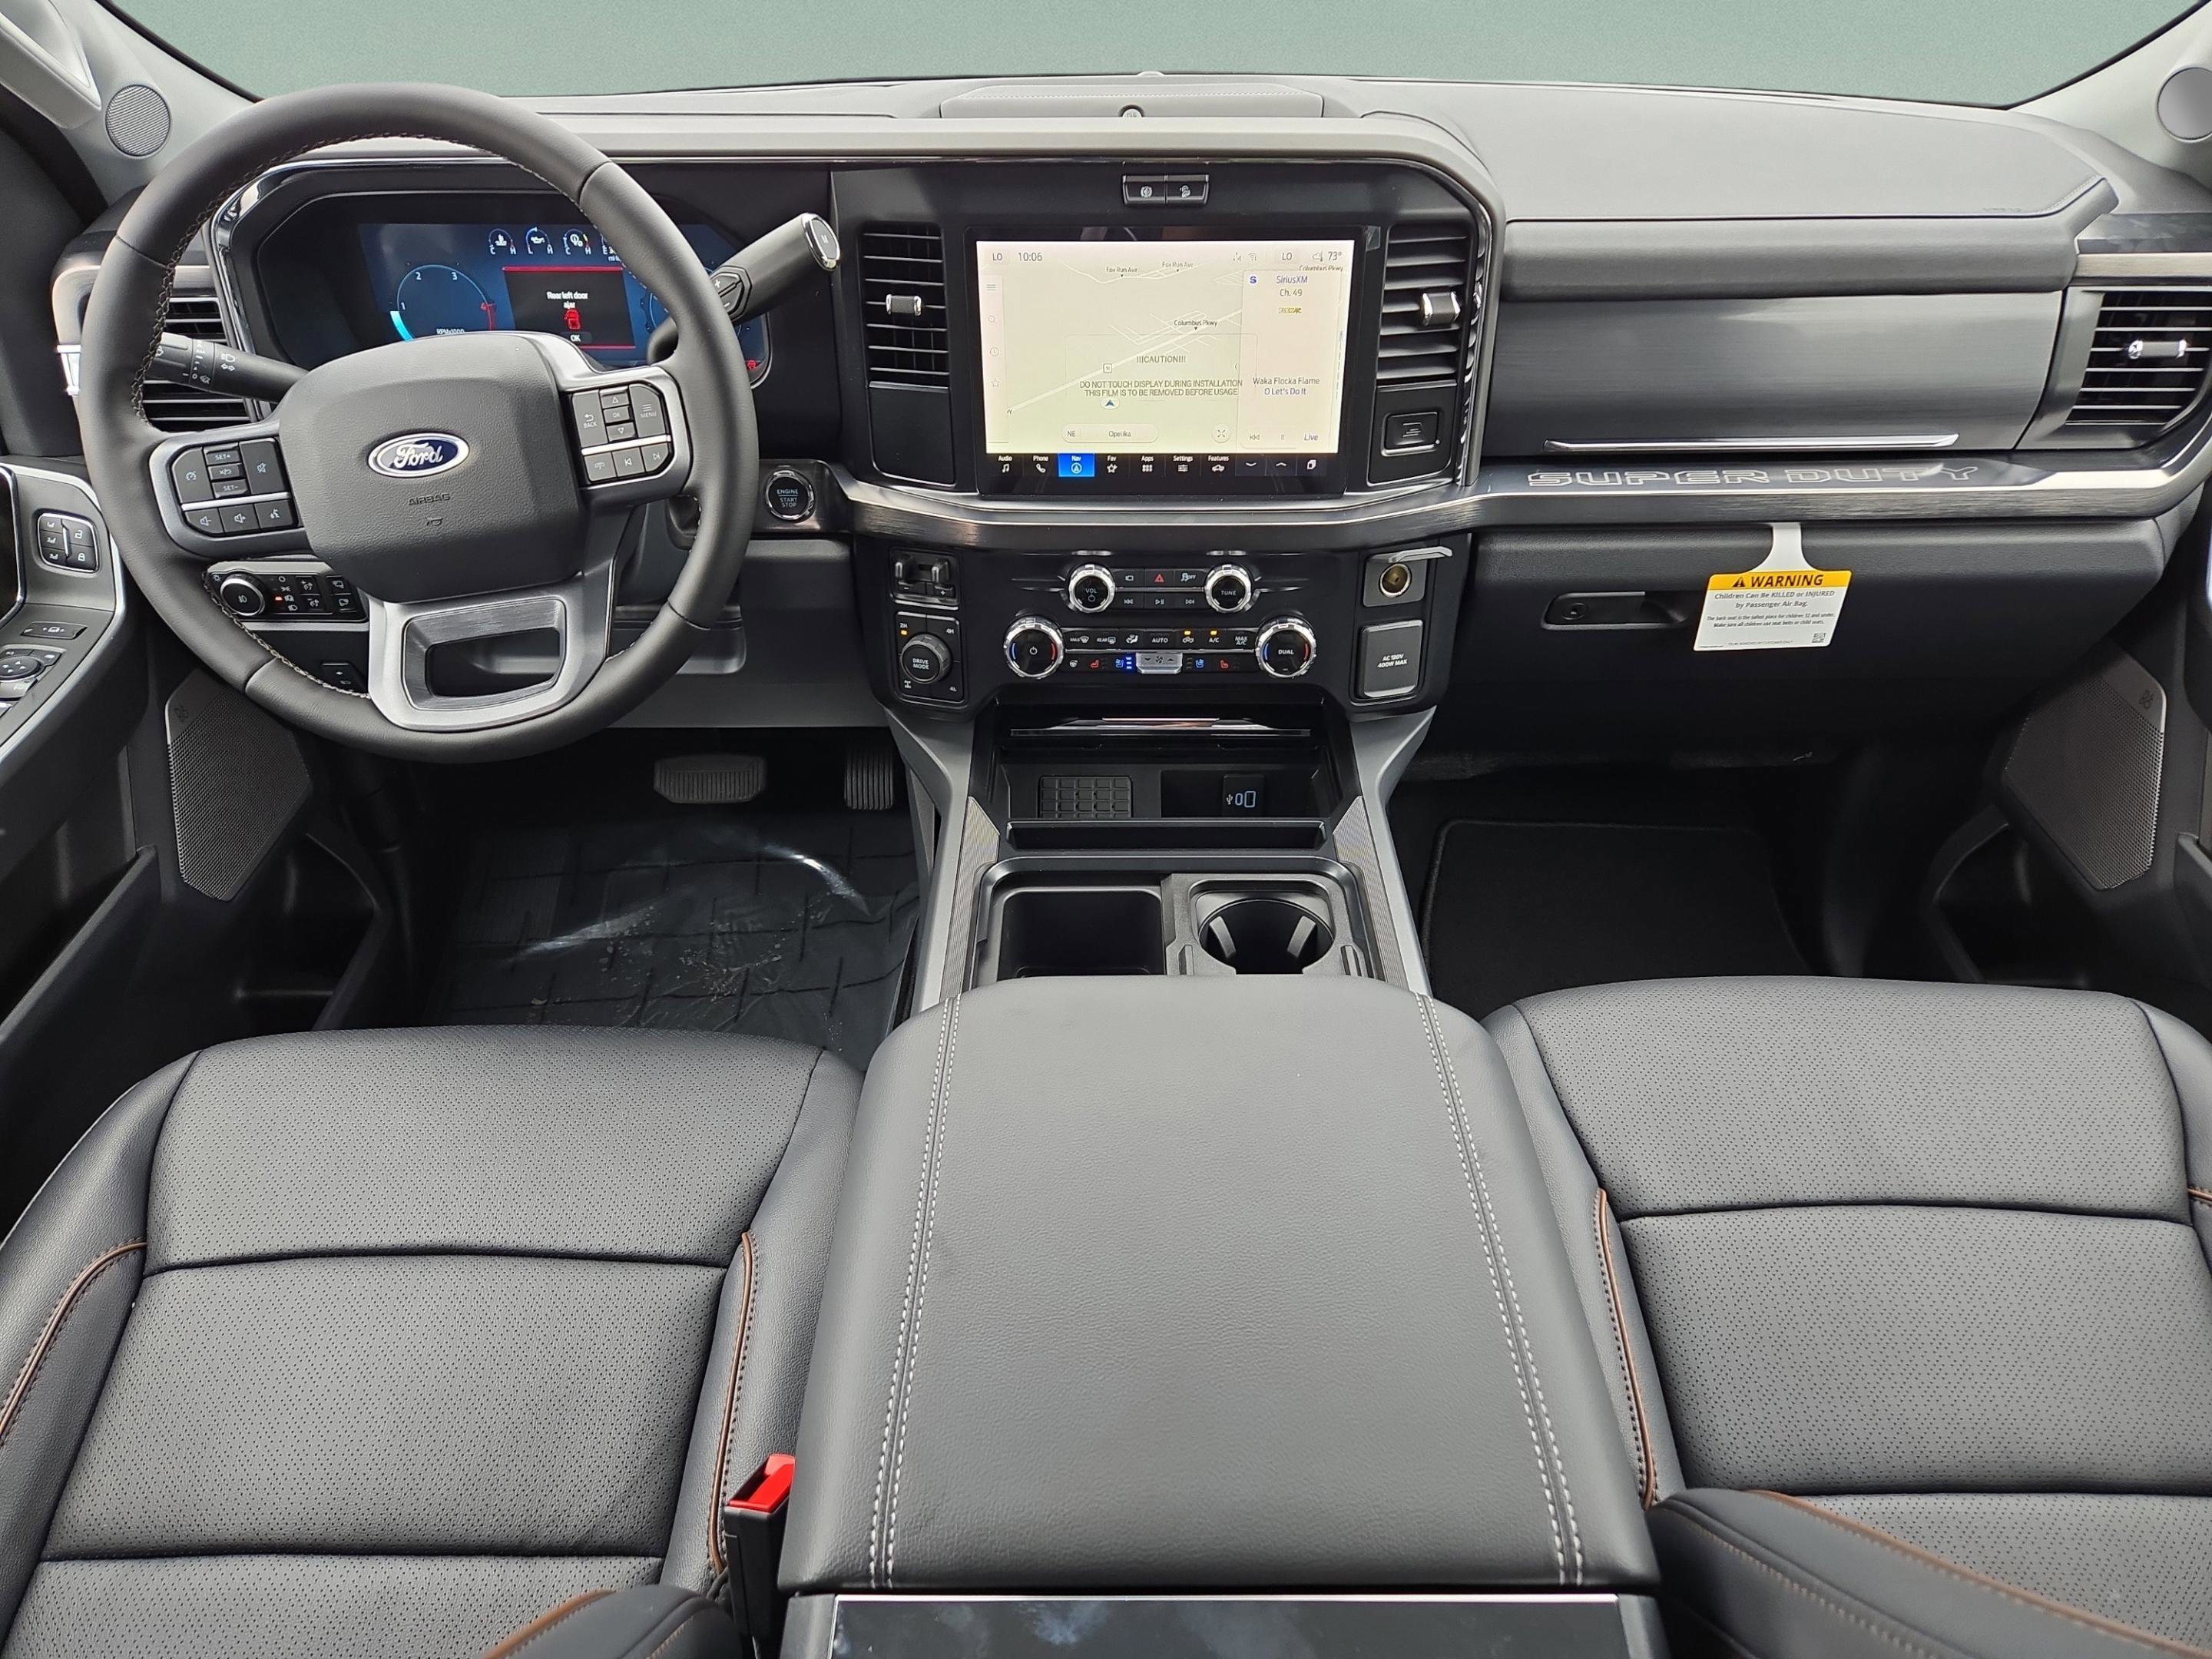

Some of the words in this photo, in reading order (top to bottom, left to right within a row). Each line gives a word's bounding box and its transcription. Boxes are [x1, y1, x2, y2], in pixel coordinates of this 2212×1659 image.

[992, 253, 1003, 261] LO
[1018, 252, 1043, 262] 10:06
[1282, 252, 1293, 260] LO
[1327, 251, 1343, 261] 73°
[415, 272, 422, 280] 2
[451, 272, 458, 280] 3
[1277, 275, 1308, 284] SiriusXM
[546, 291, 561, 300] Rear
[561, 291, 573, 300] left
[573, 291, 588, 300] door
[1280, 289, 1291, 297] Ch.
[1293, 289, 1303, 297] 49
[401, 302, 406, 310] 1
[563, 300, 576, 310] ajar
[1271, 387, 1289, 396] Let's
[393, 442, 443, 469] Ford
[1528, 469, 1770, 487] SUPER
[1784, 465, 1979, 484] DUTY
[409, 493, 450, 506] AIRBAG
[1751, 575, 1824, 588] WARNING
[1377, 660, 1395, 668] 400W
